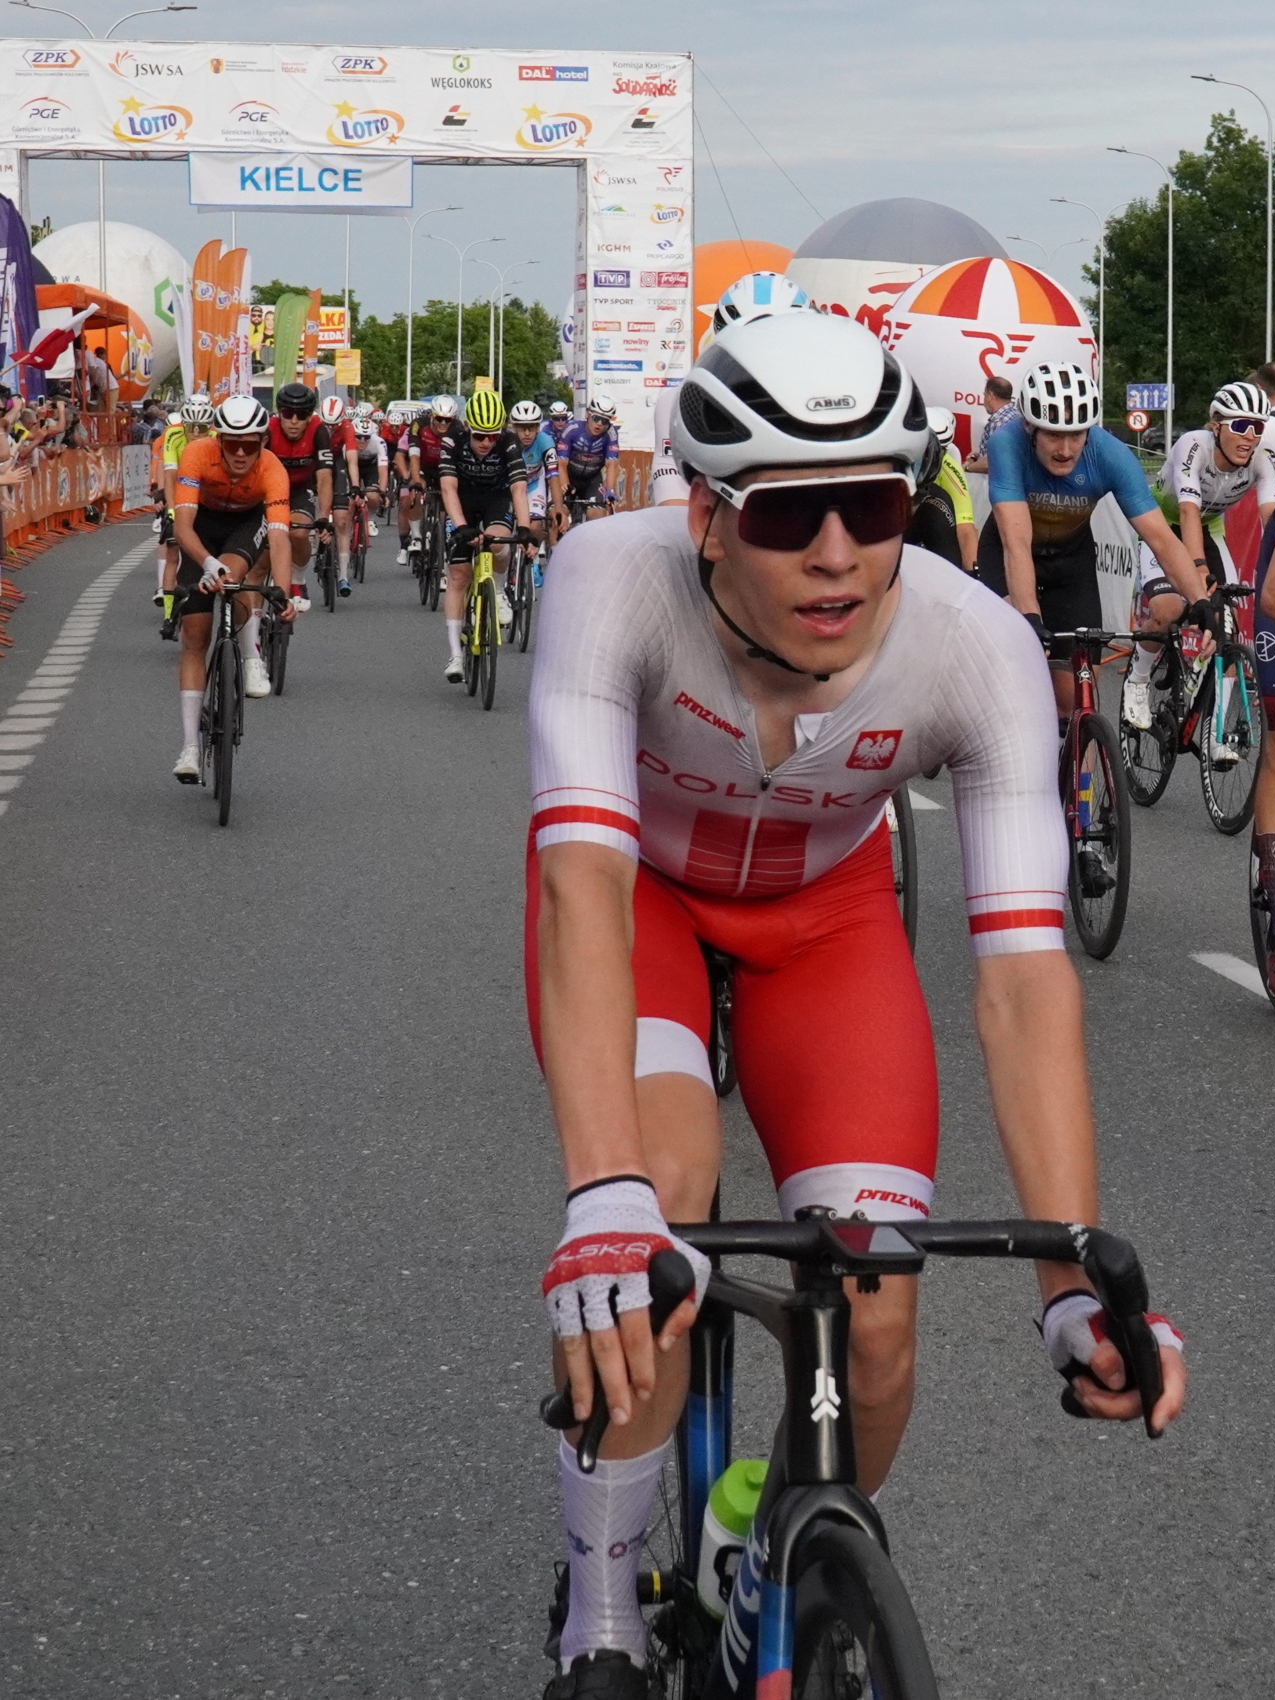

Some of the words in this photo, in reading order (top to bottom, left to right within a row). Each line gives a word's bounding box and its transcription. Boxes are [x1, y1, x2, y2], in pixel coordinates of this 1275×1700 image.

[32, 52, 68, 63] ZPK
[341, 58, 376, 69] ZPK
[134, 63, 165, 78] JSW
[168, 64, 184, 76] SA
[613, 61, 644, 70] Komisja
[645, 62, 677, 70] Krajowa
[521, 67, 550, 80] DAL
[555, 67, 588, 80] hotel
[431, 77, 493, 90] WĘGLOKOKS
[29, 108, 61, 119] PGE
[238, 111, 270, 122] PGE
[128, 112, 178, 136] LOTTO
[341, 117, 389, 139] LOTTO
[531, 120, 577, 143] LOTTO
[240, 167, 363, 192] KIELCE
[657, 210, 679, 220] LOTTO
[597, 244, 631, 252] KGHM
[600, 274, 626, 284] TVP
[813, 398, 850, 409] ABUS
[1181, 442, 1200, 473] VOSTER
[943, 459, 967, 491] HUNGARY
[1028, 492, 1088, 507] SVEALAND
[673, 690, 747, 741] prinzwear
[636, 748, 896, 809] POLSKA
